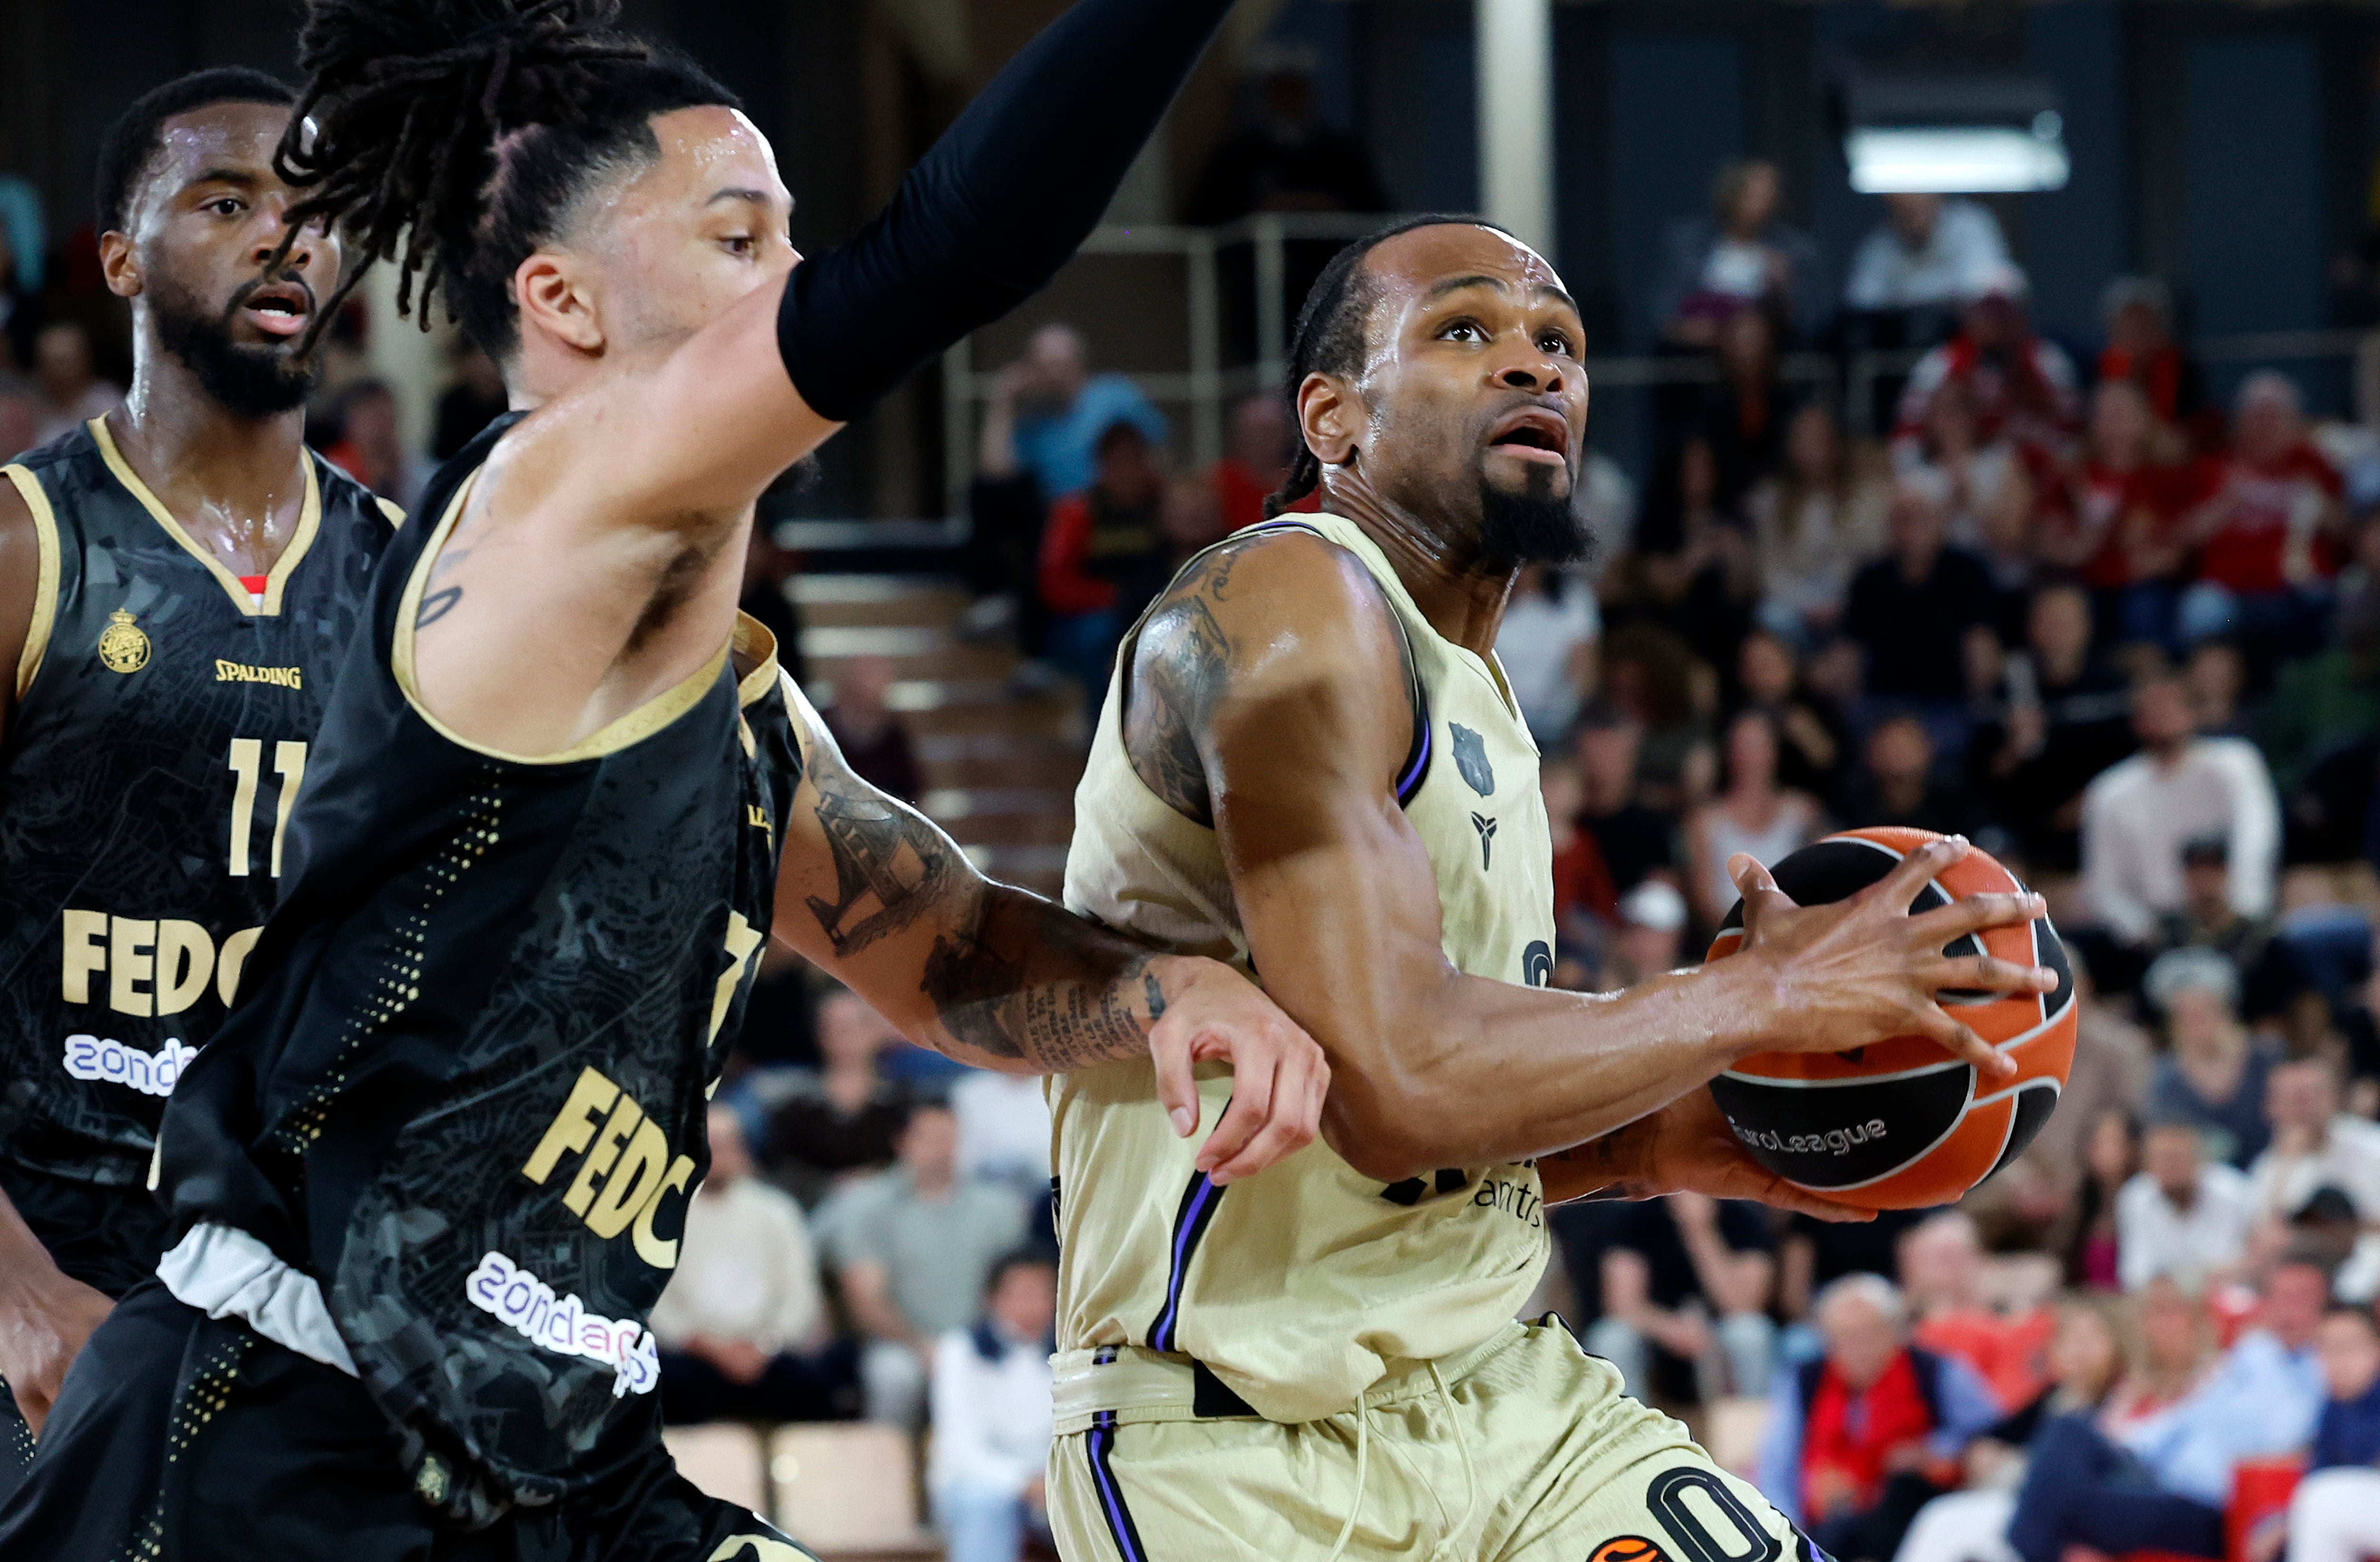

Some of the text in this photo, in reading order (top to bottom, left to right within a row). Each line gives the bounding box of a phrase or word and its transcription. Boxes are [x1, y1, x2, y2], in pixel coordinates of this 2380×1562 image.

[215, 658, 301, 690] SPALDING
[228, 738, 307, 877] 11
[73, 1042, 193, 1087] zond
